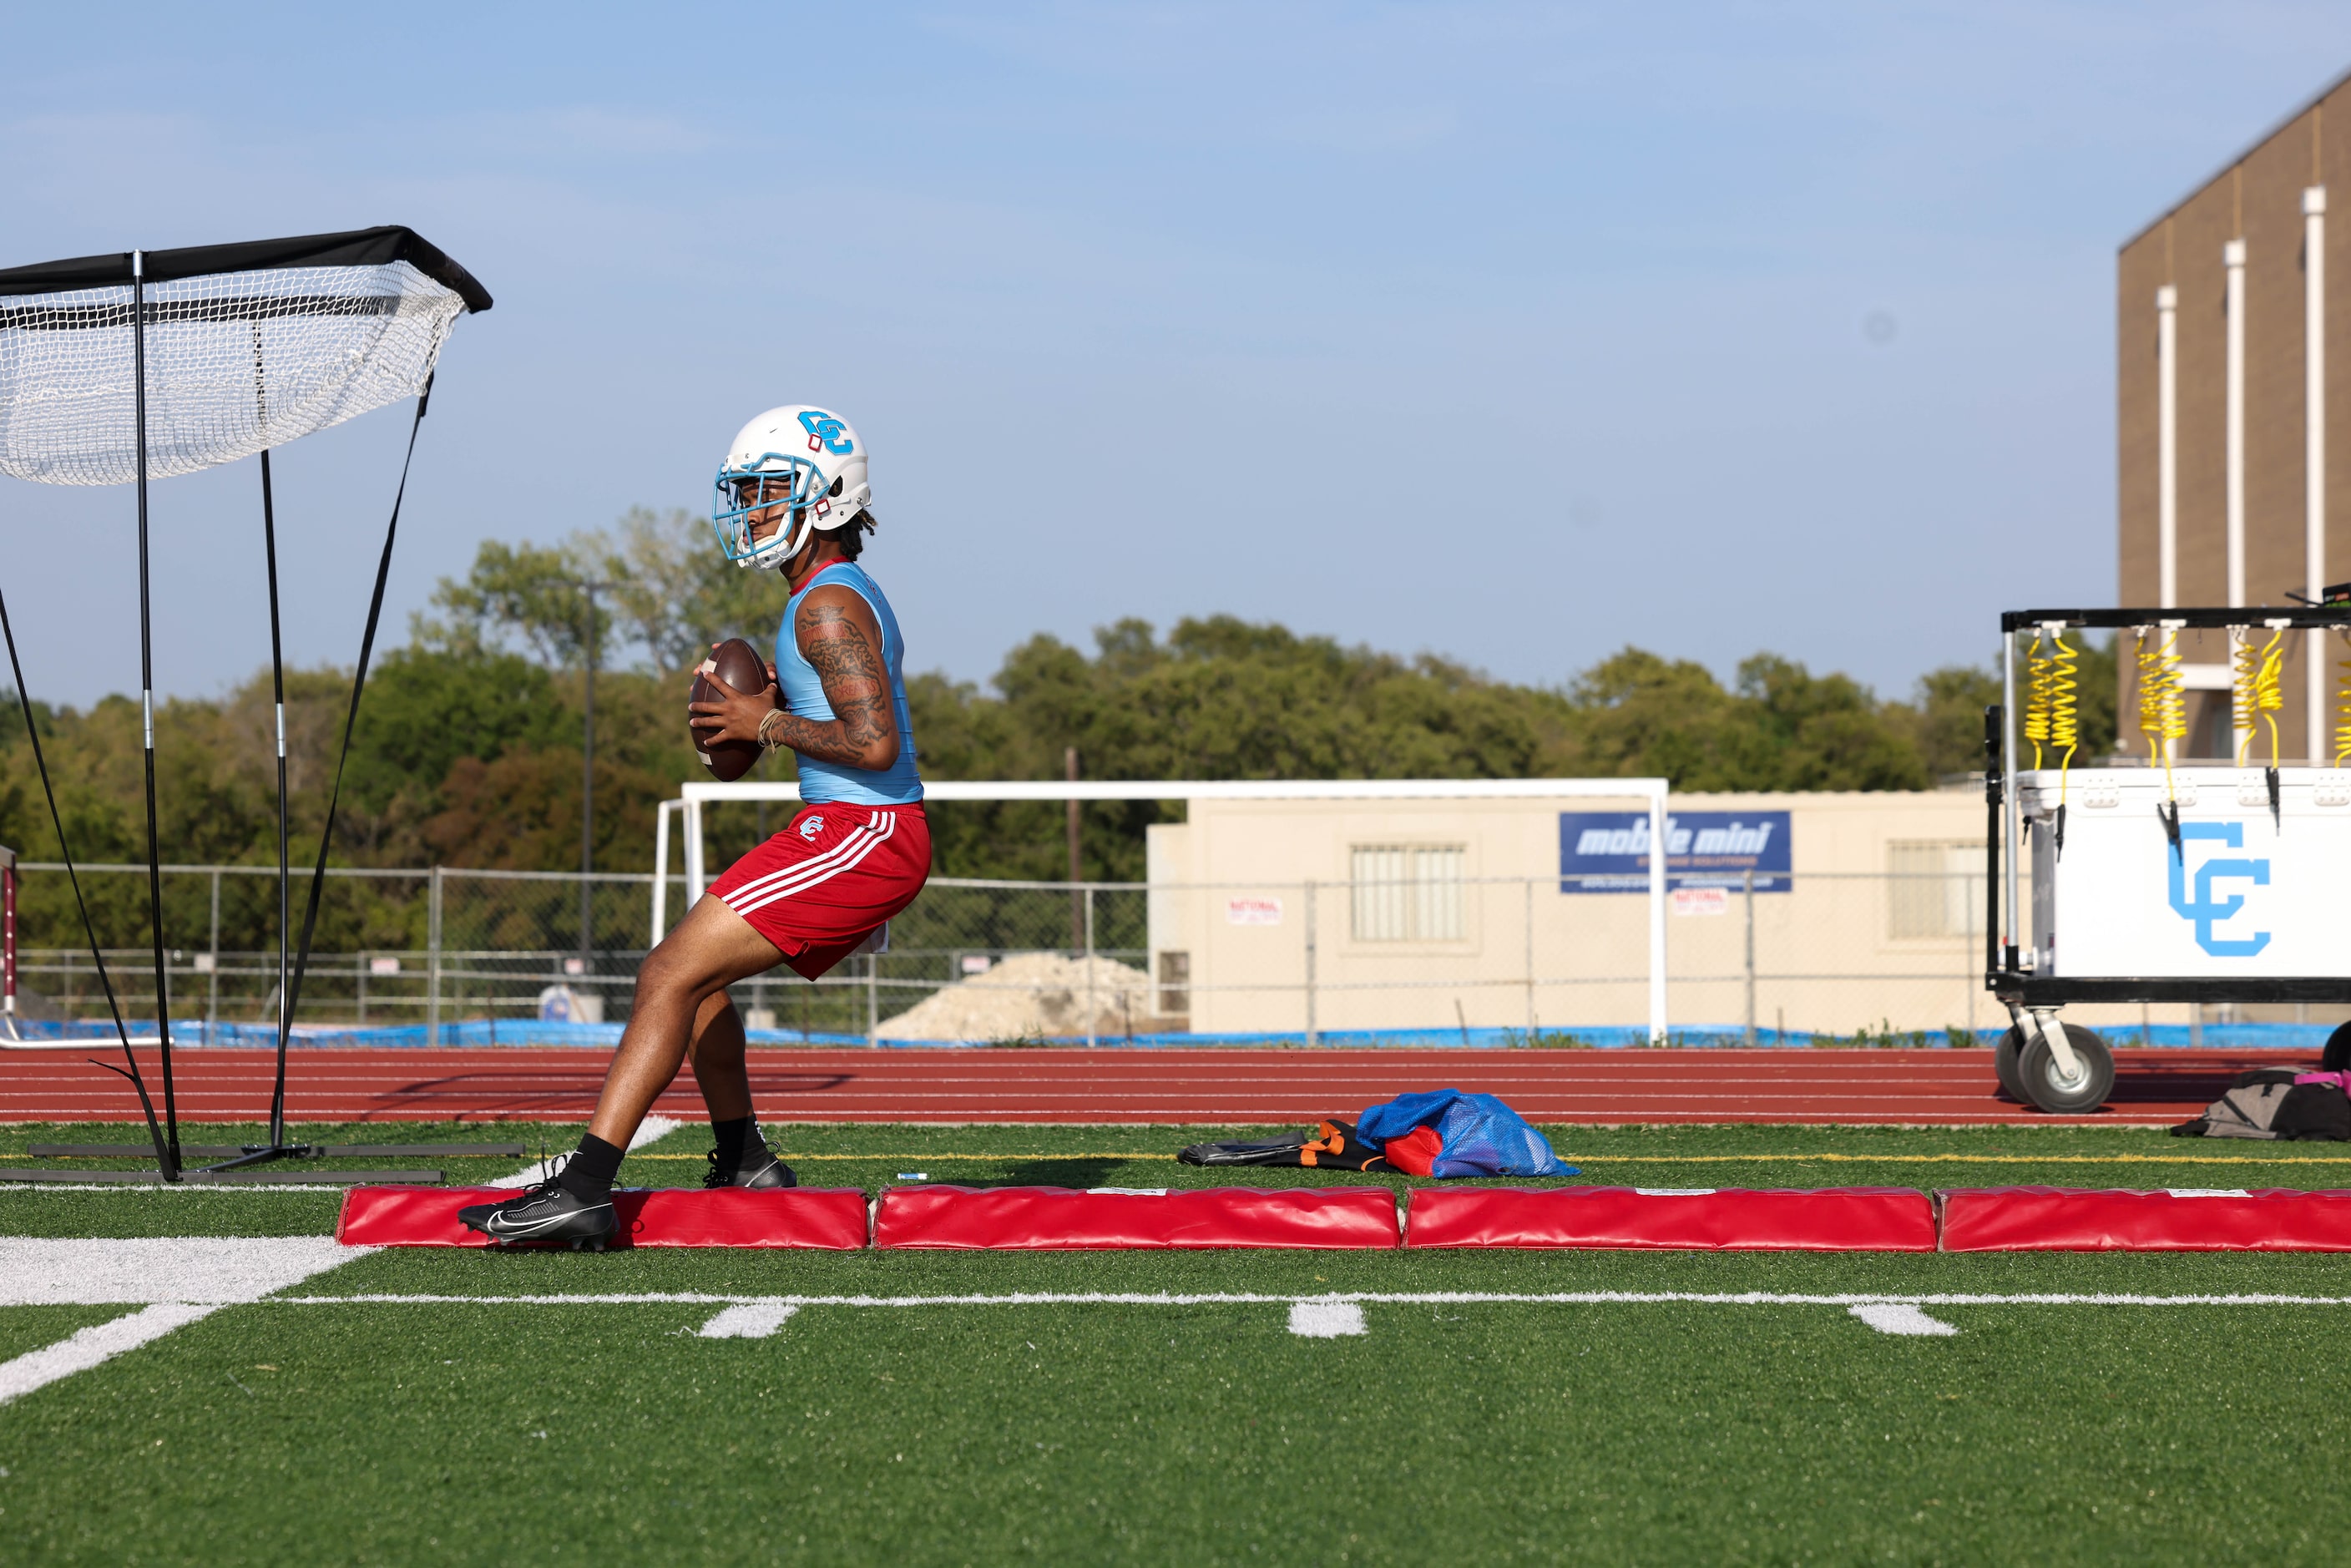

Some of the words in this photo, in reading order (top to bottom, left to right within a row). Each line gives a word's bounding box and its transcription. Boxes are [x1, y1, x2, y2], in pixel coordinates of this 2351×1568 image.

[799, 815, 824, 842] CC
[1576, 817, 1692, 855] moble
[1692, 822, 1774, 855] mini
[2168, 822, 2271, 957] CC
